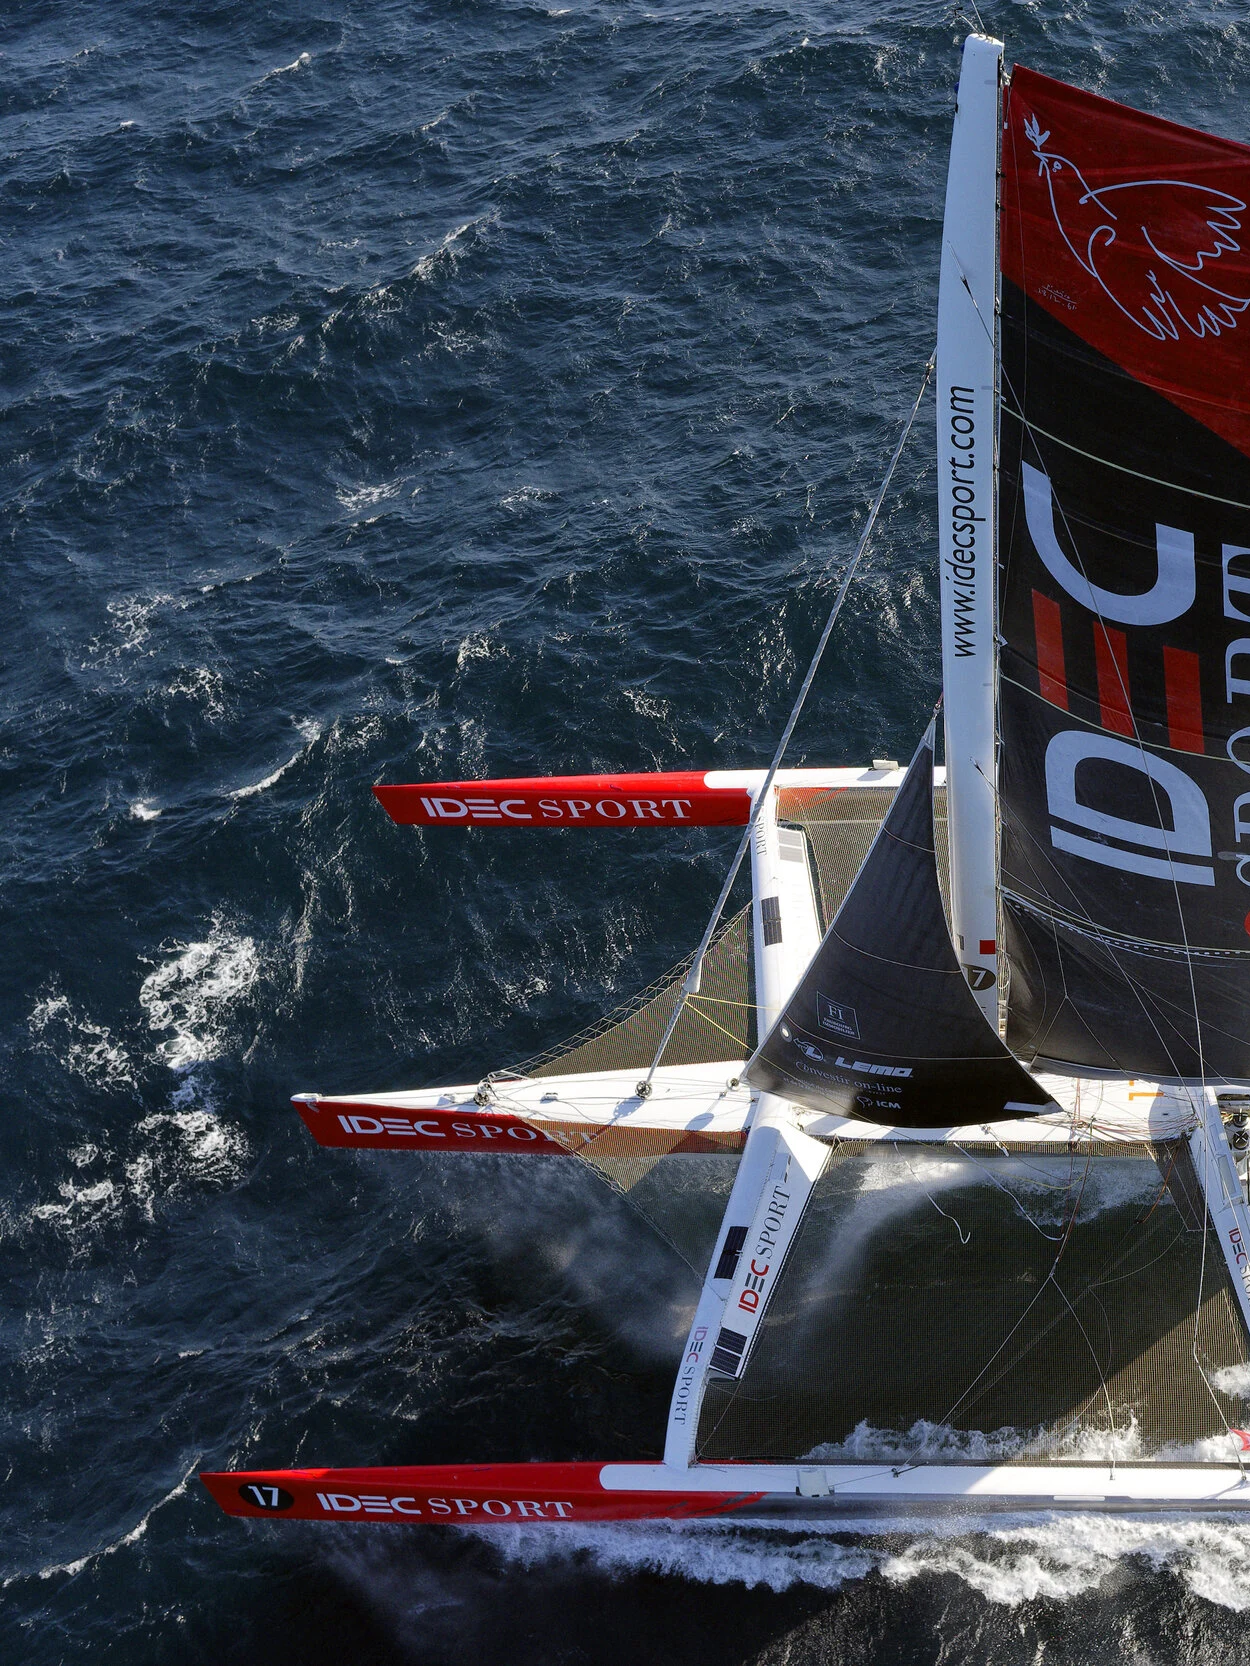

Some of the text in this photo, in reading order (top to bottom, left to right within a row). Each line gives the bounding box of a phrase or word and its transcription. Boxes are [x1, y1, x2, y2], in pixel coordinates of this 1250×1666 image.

[945, 385, 986, 657] www.idecsport.com
[1022, 460, 1215, 886] IDEC
[420, 797, 692, 819] IDEC SPORT
[828, 1004, 844, 1020] FI
[854, 1081, 903, 1094] on-line
[876, 1100, 902, 1111] ICM
[337, 1115, 446, 1137] IDEC
[738, 1186, 791, 1314] IDEC SPORT
[1228, 1227, 1249, 1265] IDEC
[674, 1326, 709, 1426] IDEC SPORT
[248, 1485, 280, 1507] 17
[316, 1492, 574, 1518] IDEC SPORT
